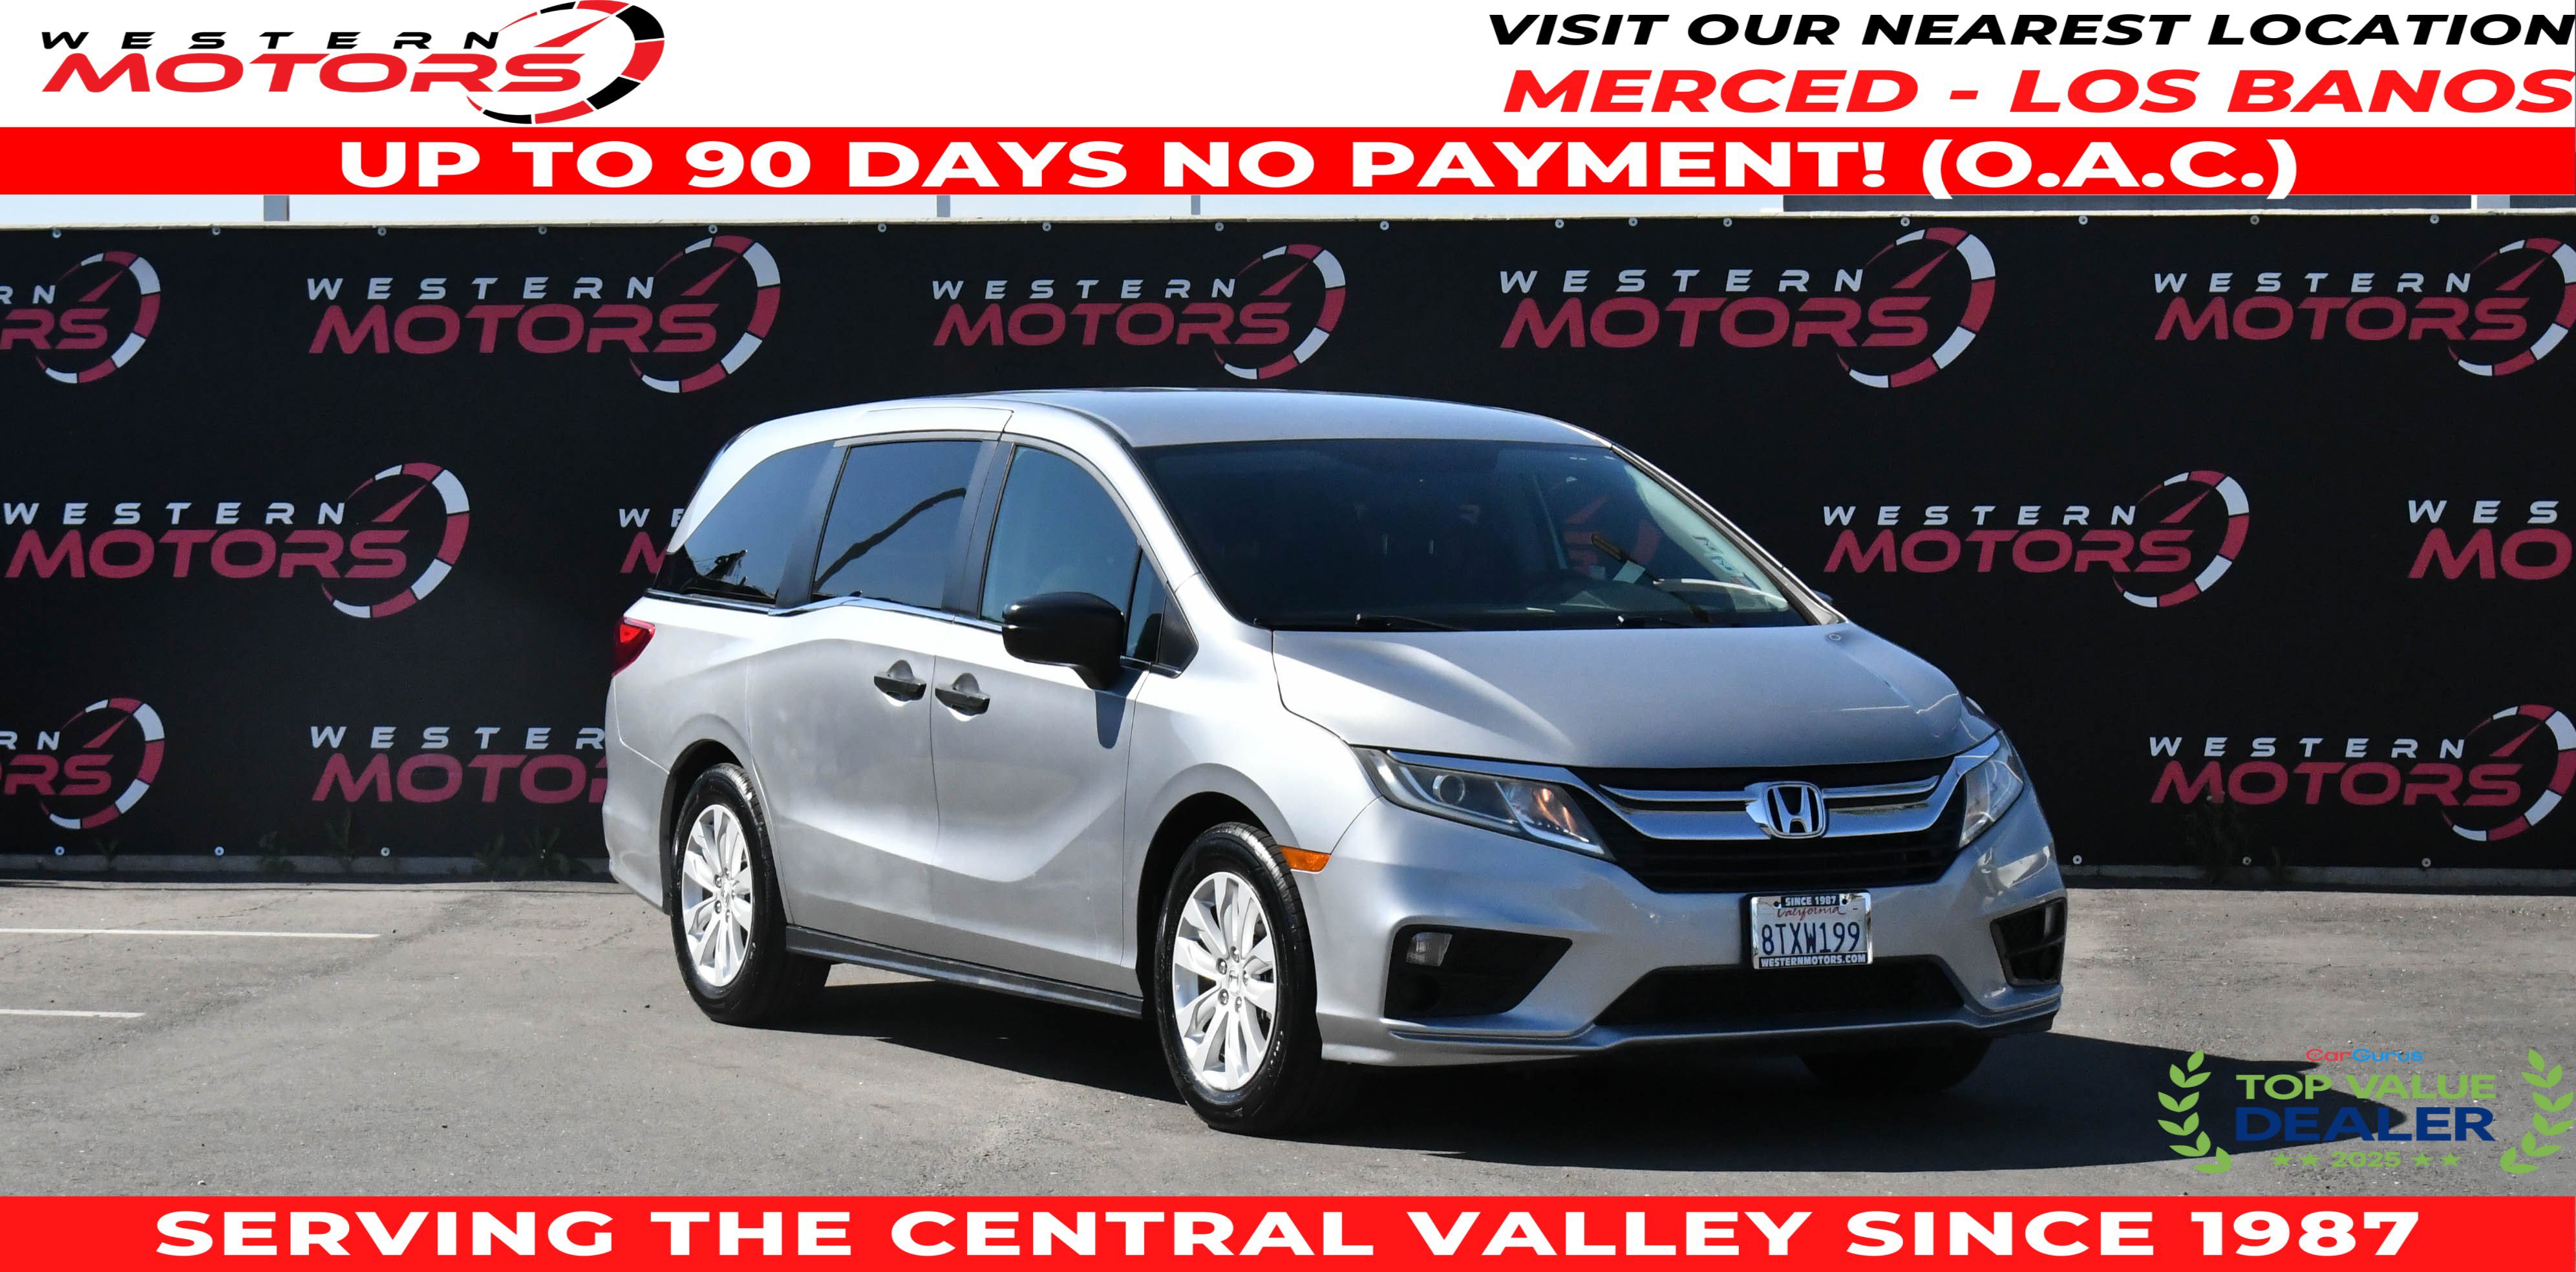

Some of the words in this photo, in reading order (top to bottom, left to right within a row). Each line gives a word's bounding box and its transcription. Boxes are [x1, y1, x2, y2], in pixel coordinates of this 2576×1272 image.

[307, 277, 654, 301] WESTERN
[932, 278, 1235, 299] WESTERN
[1500, 269, 1863, 294] WESTERN
[2155, 272, 2471, 293] WESTERN
[309, 304, 719, 354] MOTORS
[933, 302, 1292, 346] MOTORS
[1500, 297, 1932, 349] MOTORS
[2155, 296, 2530, 341] MOTORS
[3, 502, 345, 525] WESTERN
[1823, 505, 2136, 526] WESTERN
[2408, 500, 2560, 524] WES
[5, 529, 410, 579] MOTORS
[1824, 529, 2195, 574] MOTORS
[2408, 527, 2573, 580] MO
[2149, 737, 2465, 759] WESTERN
[0, 754, 114, 795] RS
[2151, 760, 2523, 806] MOTORS
[1785, 896, 1812, 906] SINCE
[1815, 895, 1836, 905] 1987
[1762, 922, 1860, 955] 8TXW199
[1761, 954, 1866, 967] WESTERNMOTORS.COM
